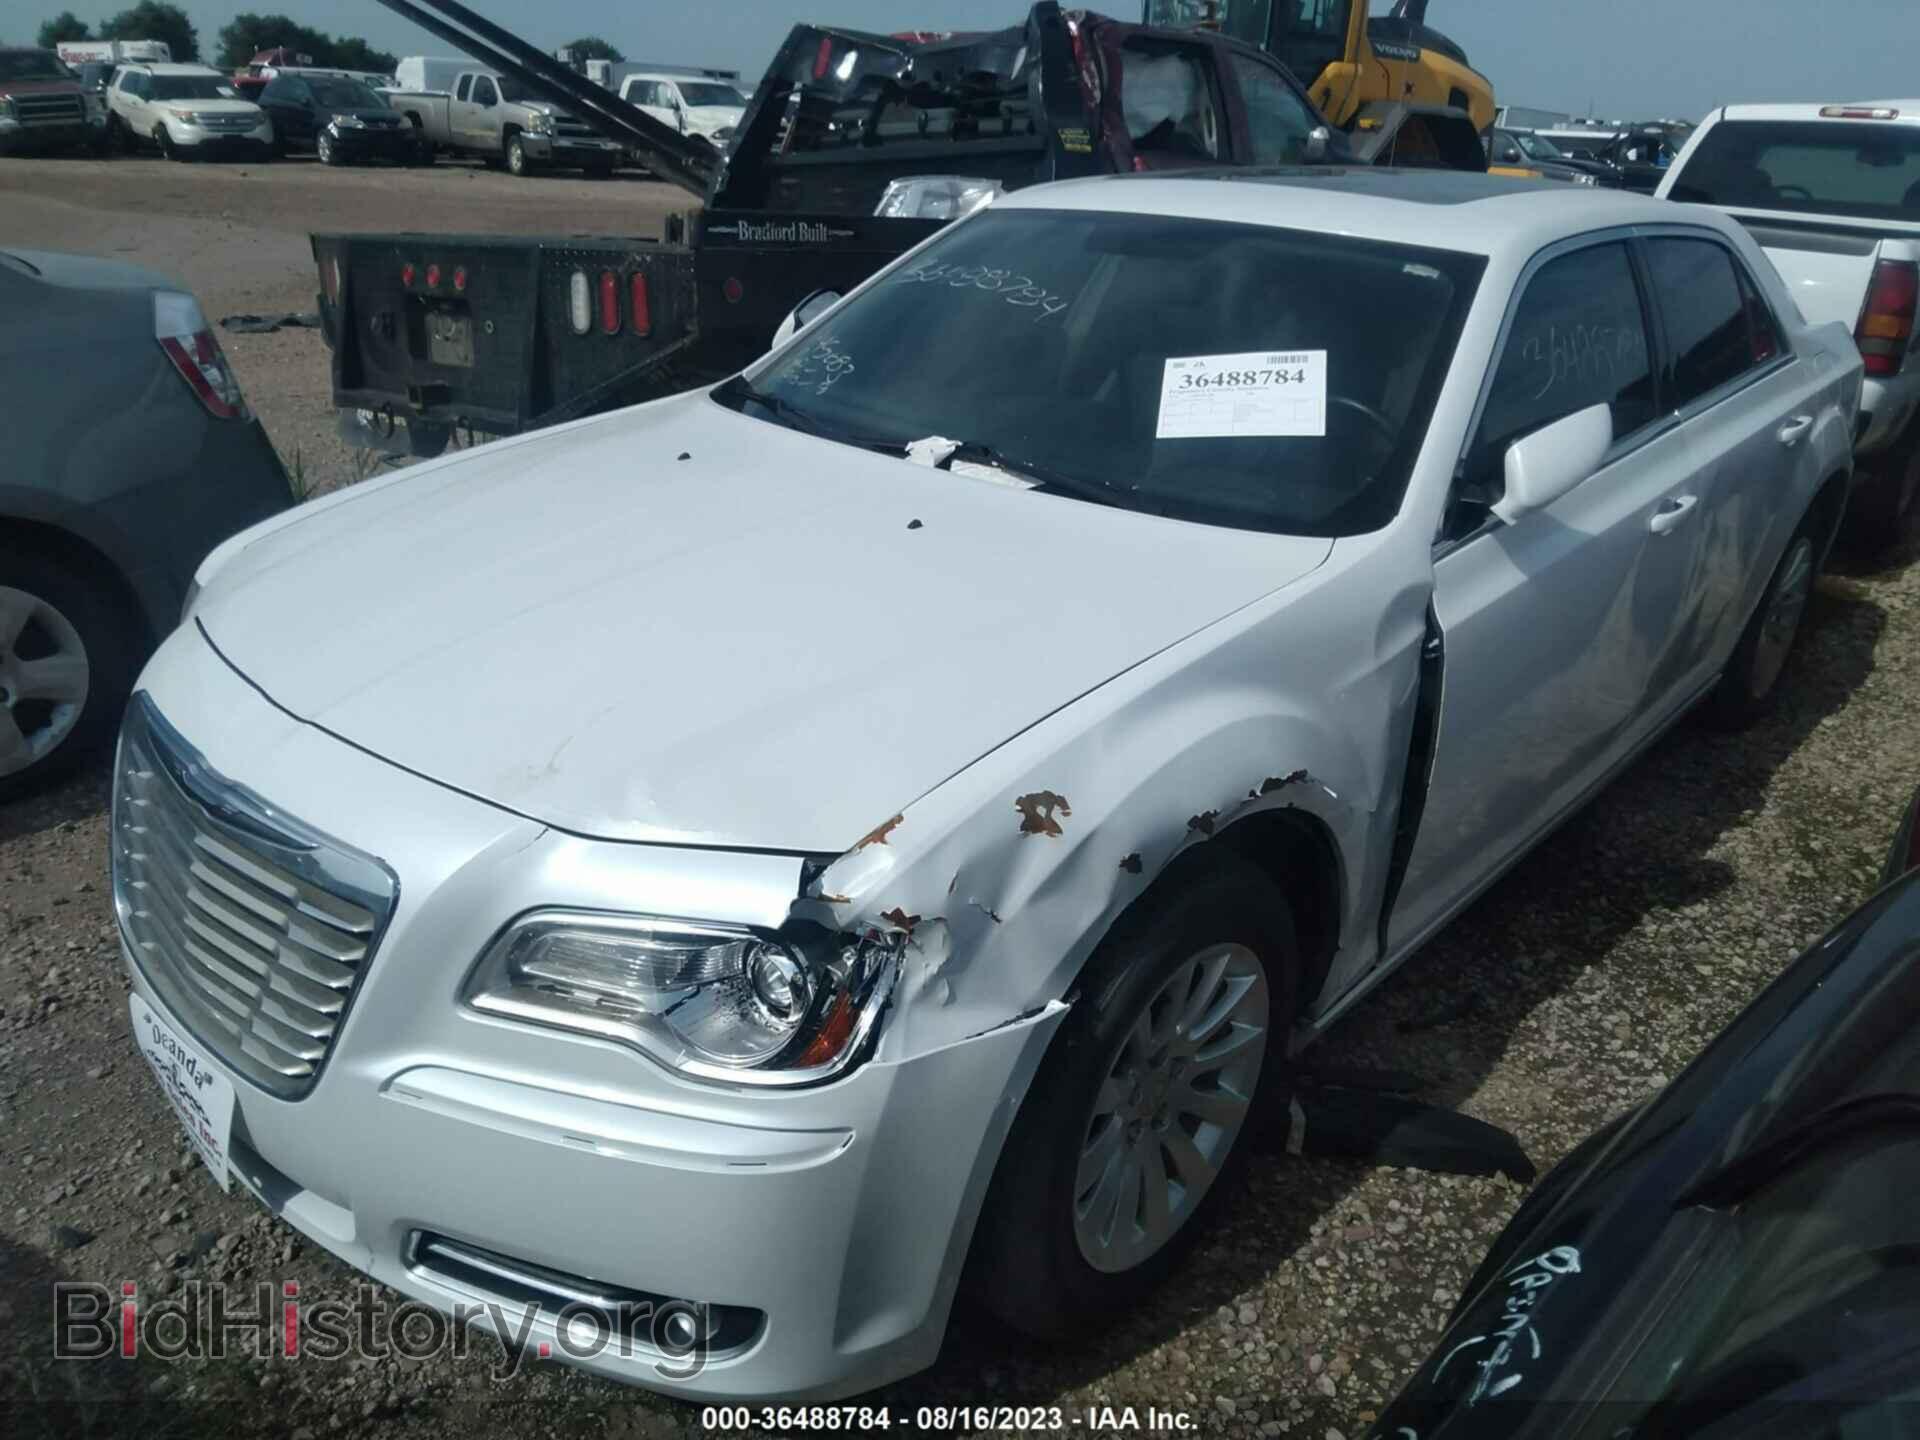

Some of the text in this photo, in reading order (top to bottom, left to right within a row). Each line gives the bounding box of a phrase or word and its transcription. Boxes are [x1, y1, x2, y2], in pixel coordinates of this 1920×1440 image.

[1375, 43, 1417, 58] VOLVO
[738, 220, 829, 242] Bradford Built
[1179, 368, 1306, 389] 36488784
